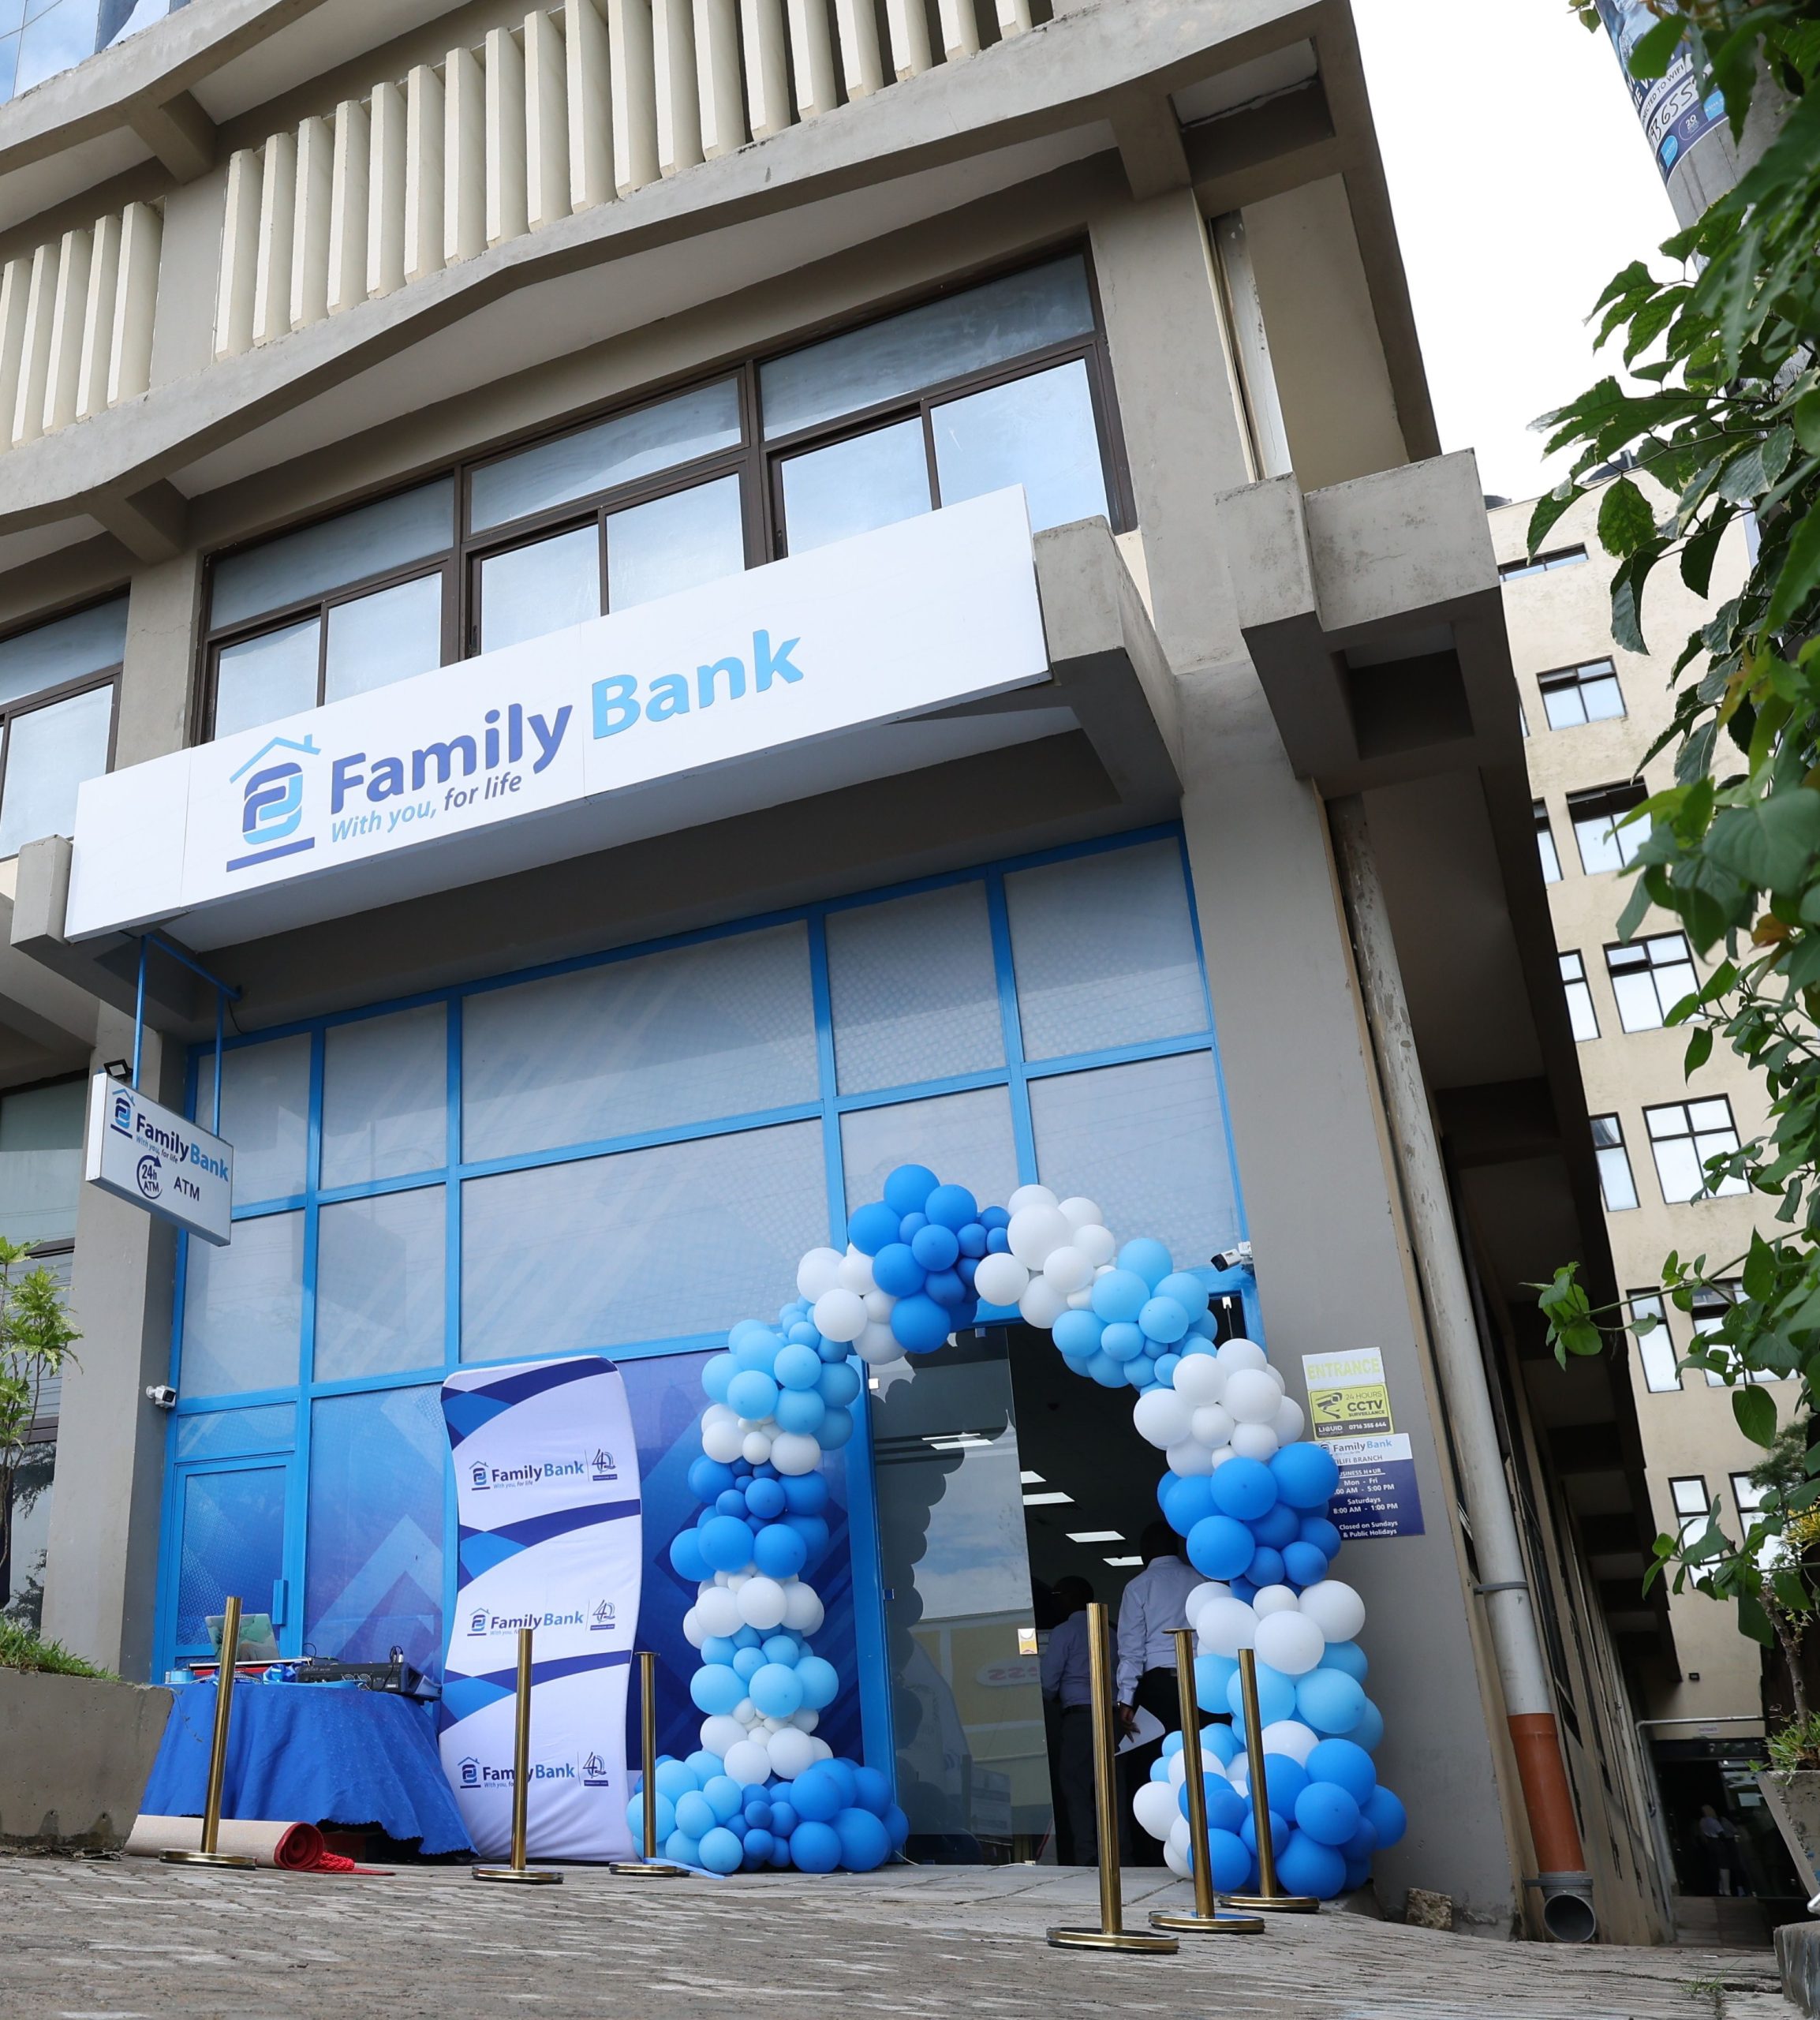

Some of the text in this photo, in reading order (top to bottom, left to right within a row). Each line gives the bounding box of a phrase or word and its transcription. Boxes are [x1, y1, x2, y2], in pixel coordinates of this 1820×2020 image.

[1657, 81, 1666, 93] TO
[1667, 64, 1684, 82] WIFI
[330, 629, 804, 815] Family Bank
[332, 772, 521, 843] With you, for life
[136, 1135, 148, 1147] With
[170, 1153, 178, 1164] life
[142, 1164, 157, 1180] 24h
[144, 1180, 159, 1192] ATM
[174, 1176, 200, 1202] ATM
[1306, 1357, 1381, 1380] ENTRANCE
[1356, 1391, 1383, 1400] HOURS
[1347, 1400, 1383, 1412] CCTV
[1353, 1454, 1383, 1463] BRANCH
[1347, 1496, 1381, 1505] Saturdays
[1371, 1520, 1399, 1529] Sundays
[1370, 1528, 1397, 1536] Holidays
